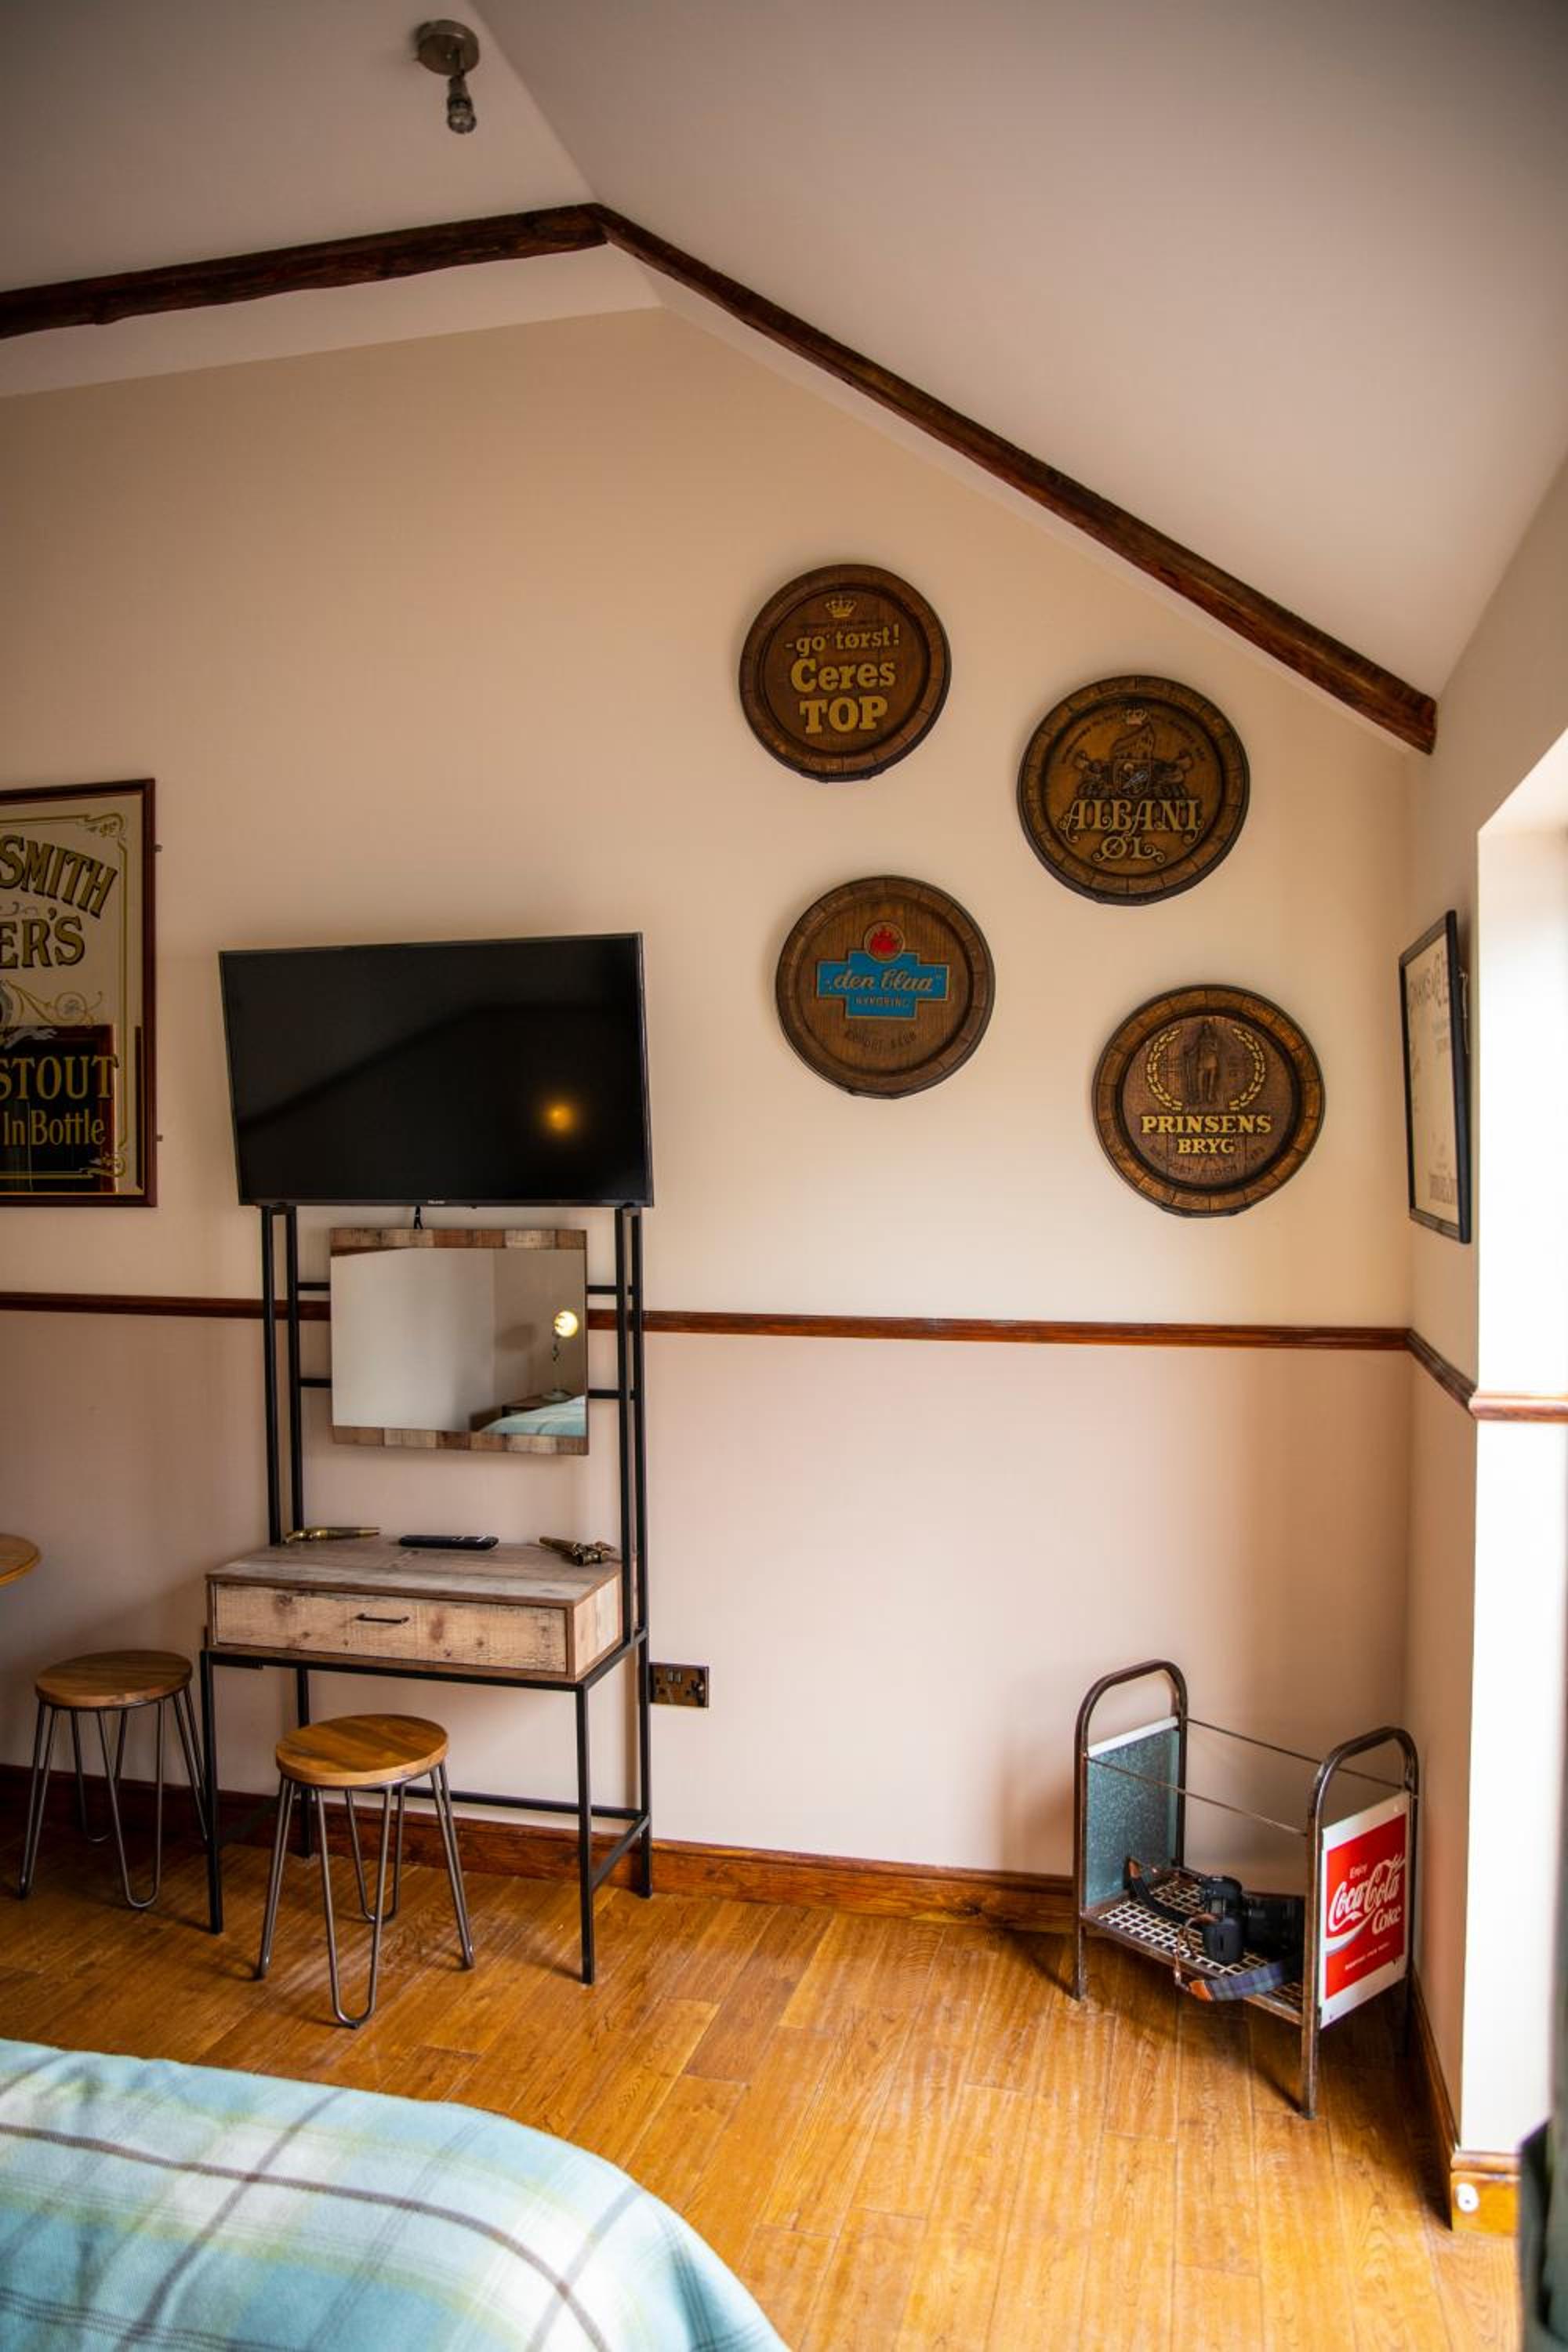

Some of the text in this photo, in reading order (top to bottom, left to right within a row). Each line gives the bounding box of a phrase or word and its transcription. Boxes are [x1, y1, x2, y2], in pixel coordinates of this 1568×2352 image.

[790, 658, 896, 693] Ceres
[799, 695, 888, 735] TOP
[1060, 799, 1204, 843] ALBANI
[0, 835, 118, 919] SMITH
[0, 1054, 119, 1101] STOUT
[3, 1109, 107, 1146] In Bottle
[1141, 1114, 1272, 1134] PRINSENS
[1178, 1138, 1236, 1155] BRYG
